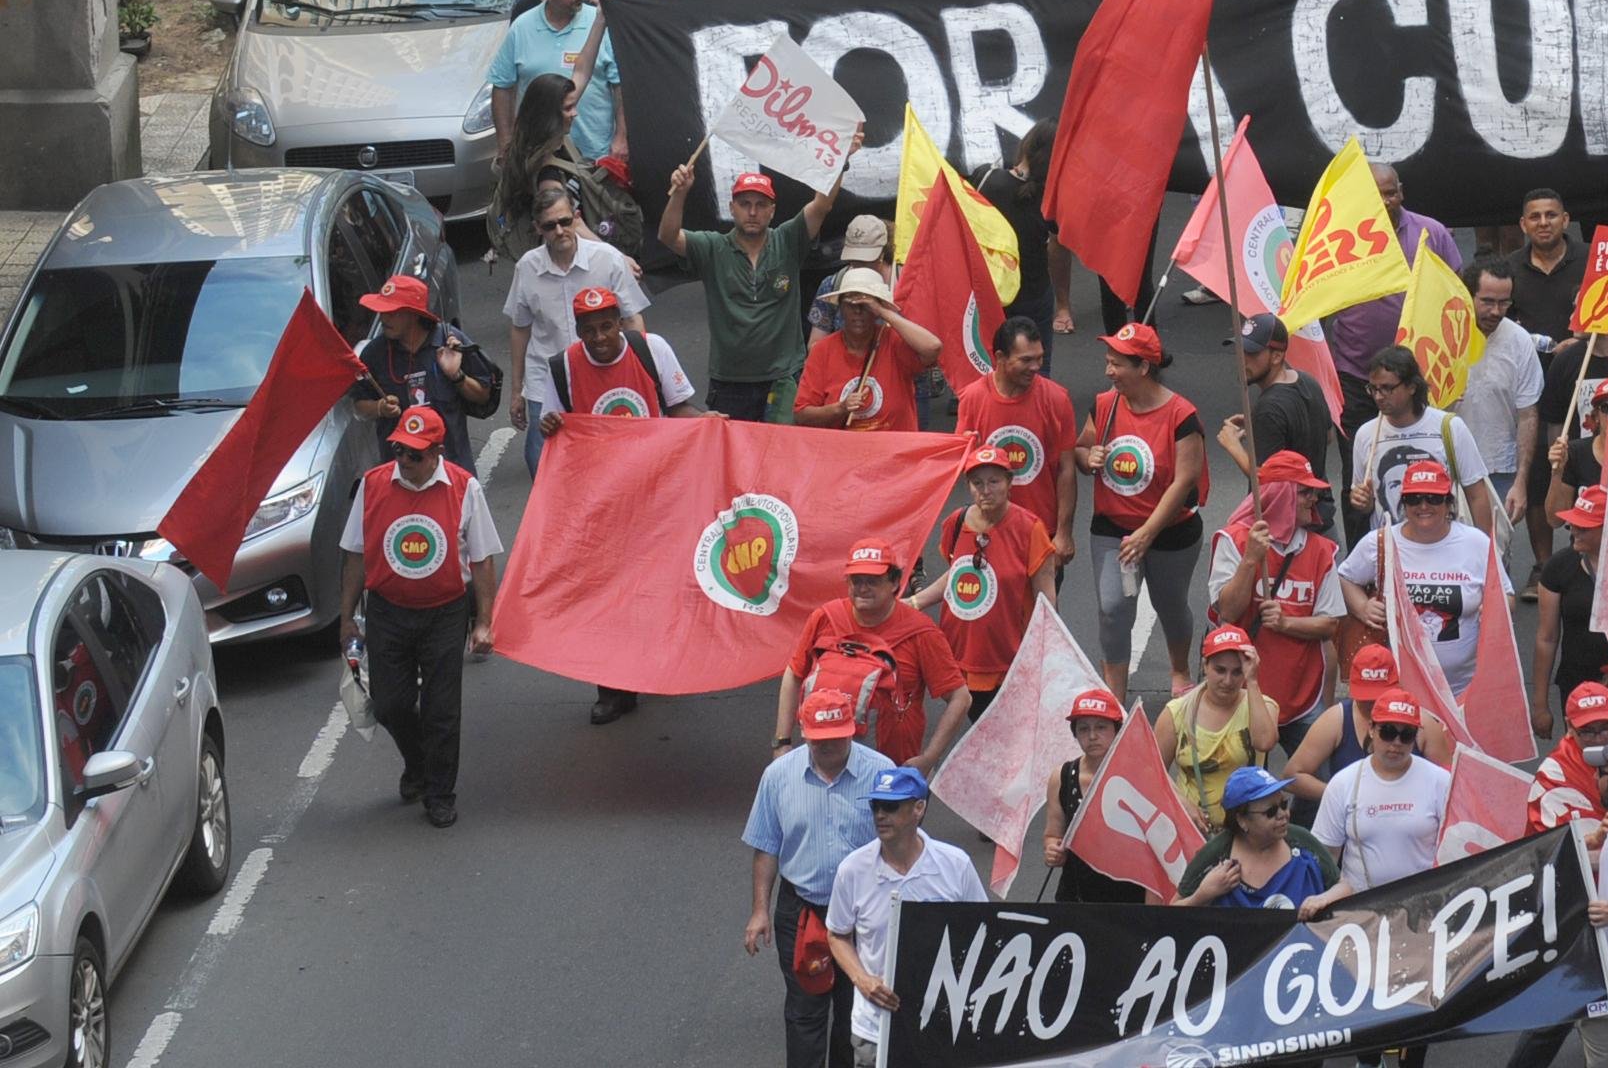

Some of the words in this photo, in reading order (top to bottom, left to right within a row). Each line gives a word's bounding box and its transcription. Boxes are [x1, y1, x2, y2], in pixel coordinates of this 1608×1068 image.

[693, 2, 1235, 221] FOR
[739, 54, 842, 156] Dilma
[814, 147, 836, 168] 13
[1247, 211, 1275, 258] CENTRAL
[1595, 254, 1603, 271] É
[1008, 451, 1026, 463] MP
[1112, 459, 1137, 473] CMP
[401, 541, 429, 553] CMP
[696, 526, 725, 573] CENTRAL
[777, 506, 797, 568] POPULARES
[1403, 571, 1427, 581] ORA
[1430, 571, 1471, 582] CUNHA
[957, 581, 980, 594] CMP
[1435, 587, 1454, 596] AO
[1409, 594, 1451, 605] GOLPE!
[1101, 775, 1188, 888] CU
[920, 911, 1087, 1045] NÃO
[1117, 935, 1229, 1037] AO
[1263, 863, 1559, 1027] GOLPE!
[1217, 1027, 1352, 1062] SINDISINDI
